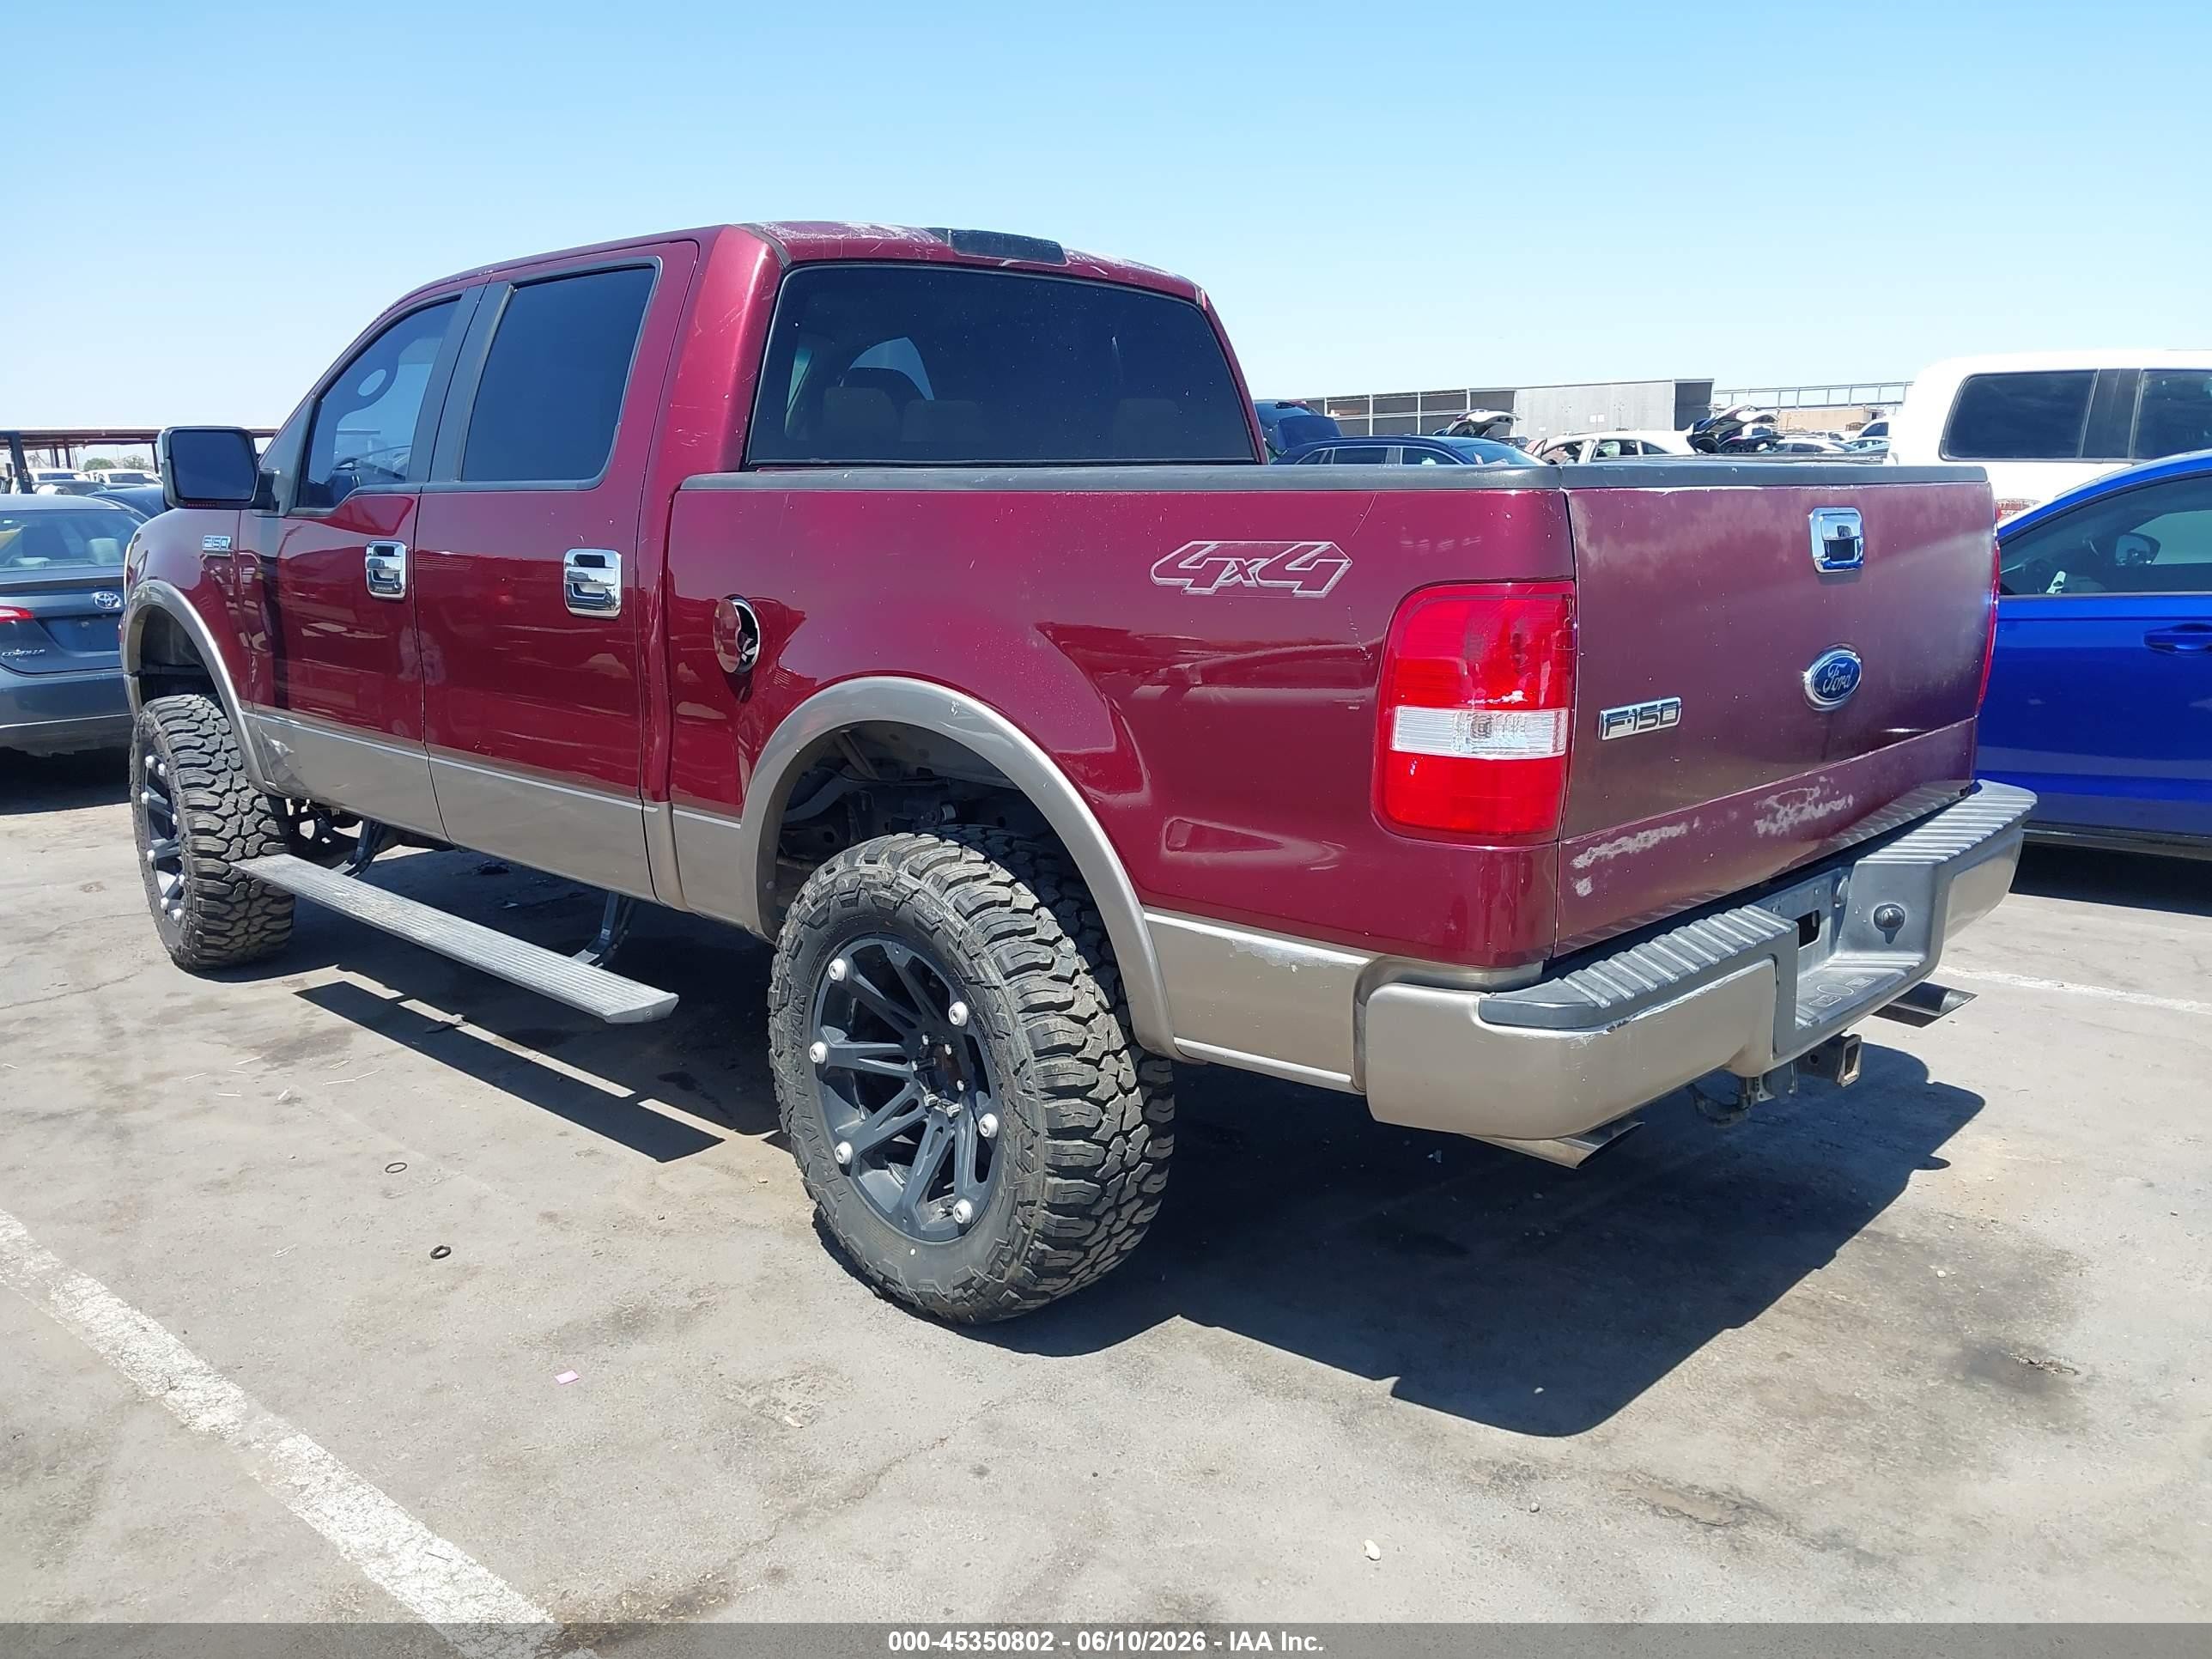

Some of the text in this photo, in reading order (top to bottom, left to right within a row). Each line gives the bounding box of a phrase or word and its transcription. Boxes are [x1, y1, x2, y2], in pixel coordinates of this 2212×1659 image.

[1150, 540, 1352, 599] 4x4
[1822, 662, 1854, 693] Ford
[1603, 700, 1680, 738] F-150
